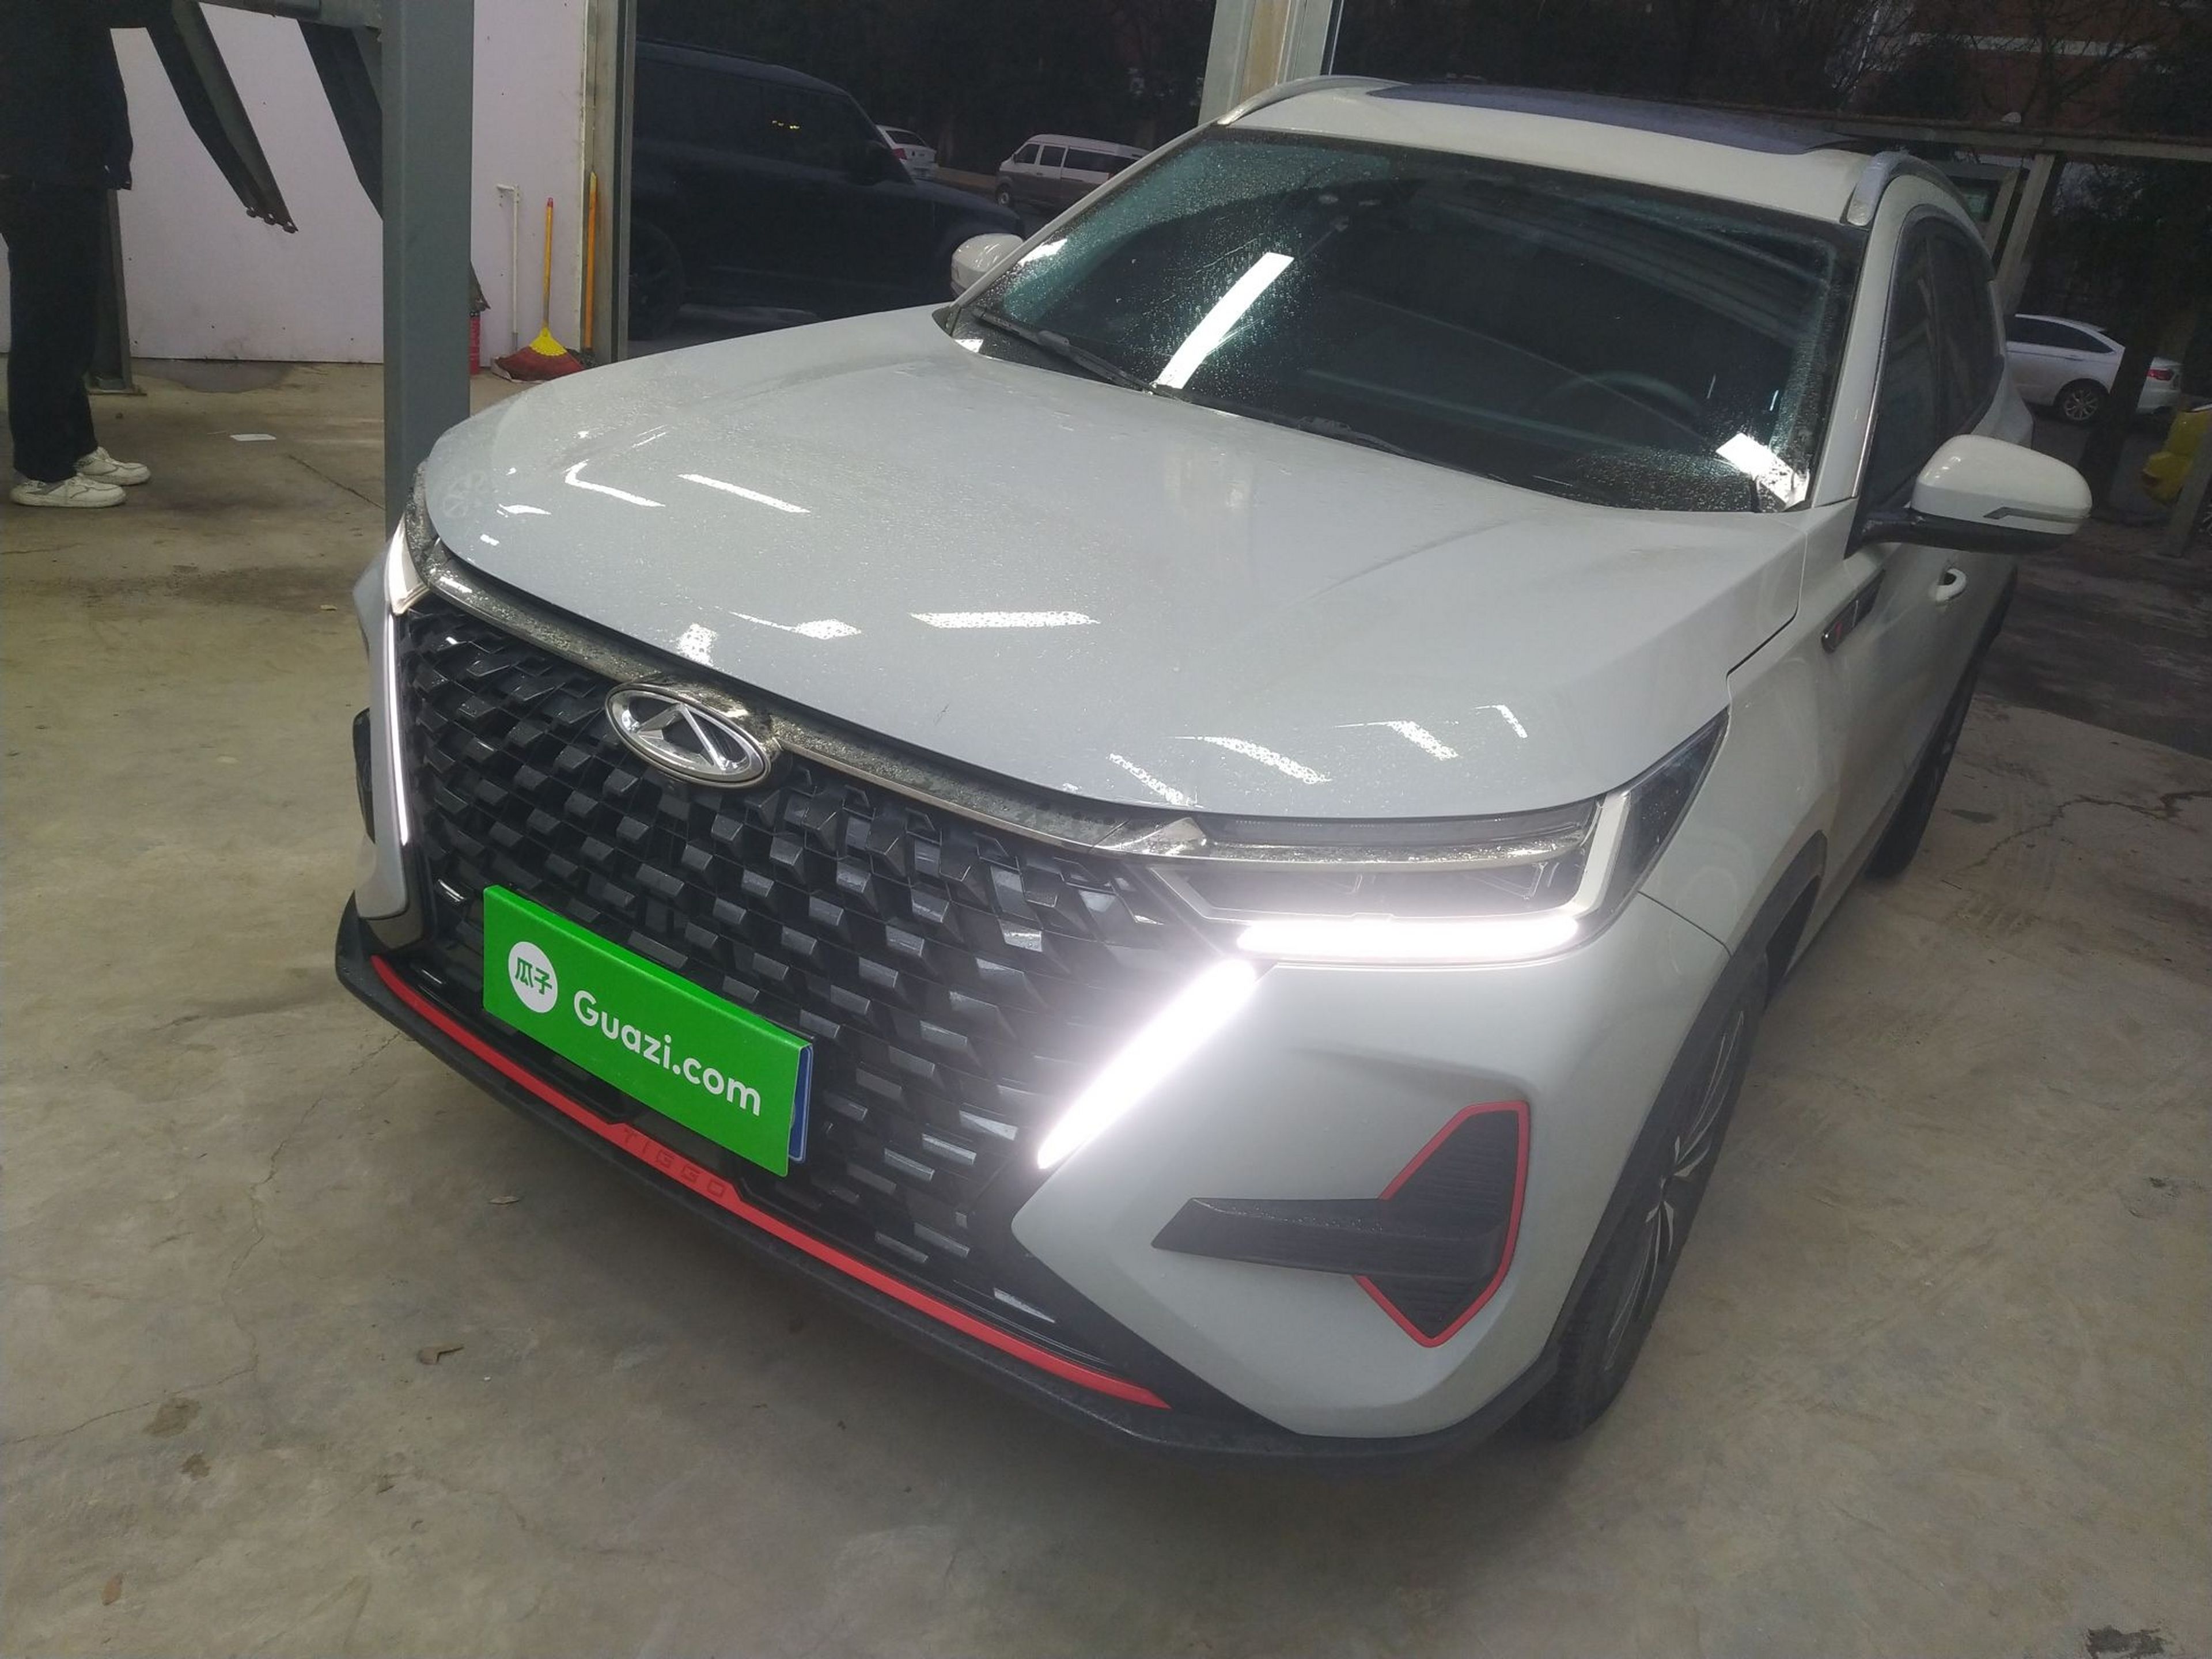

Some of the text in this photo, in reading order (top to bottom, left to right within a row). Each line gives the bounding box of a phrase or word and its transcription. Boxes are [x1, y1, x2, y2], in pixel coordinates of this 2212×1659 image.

[514, 957, 552, 995] 瓜子
[574, 990, 761, 1116] Guazi.com
[624, 1127, 726, 1198] TIGGO
